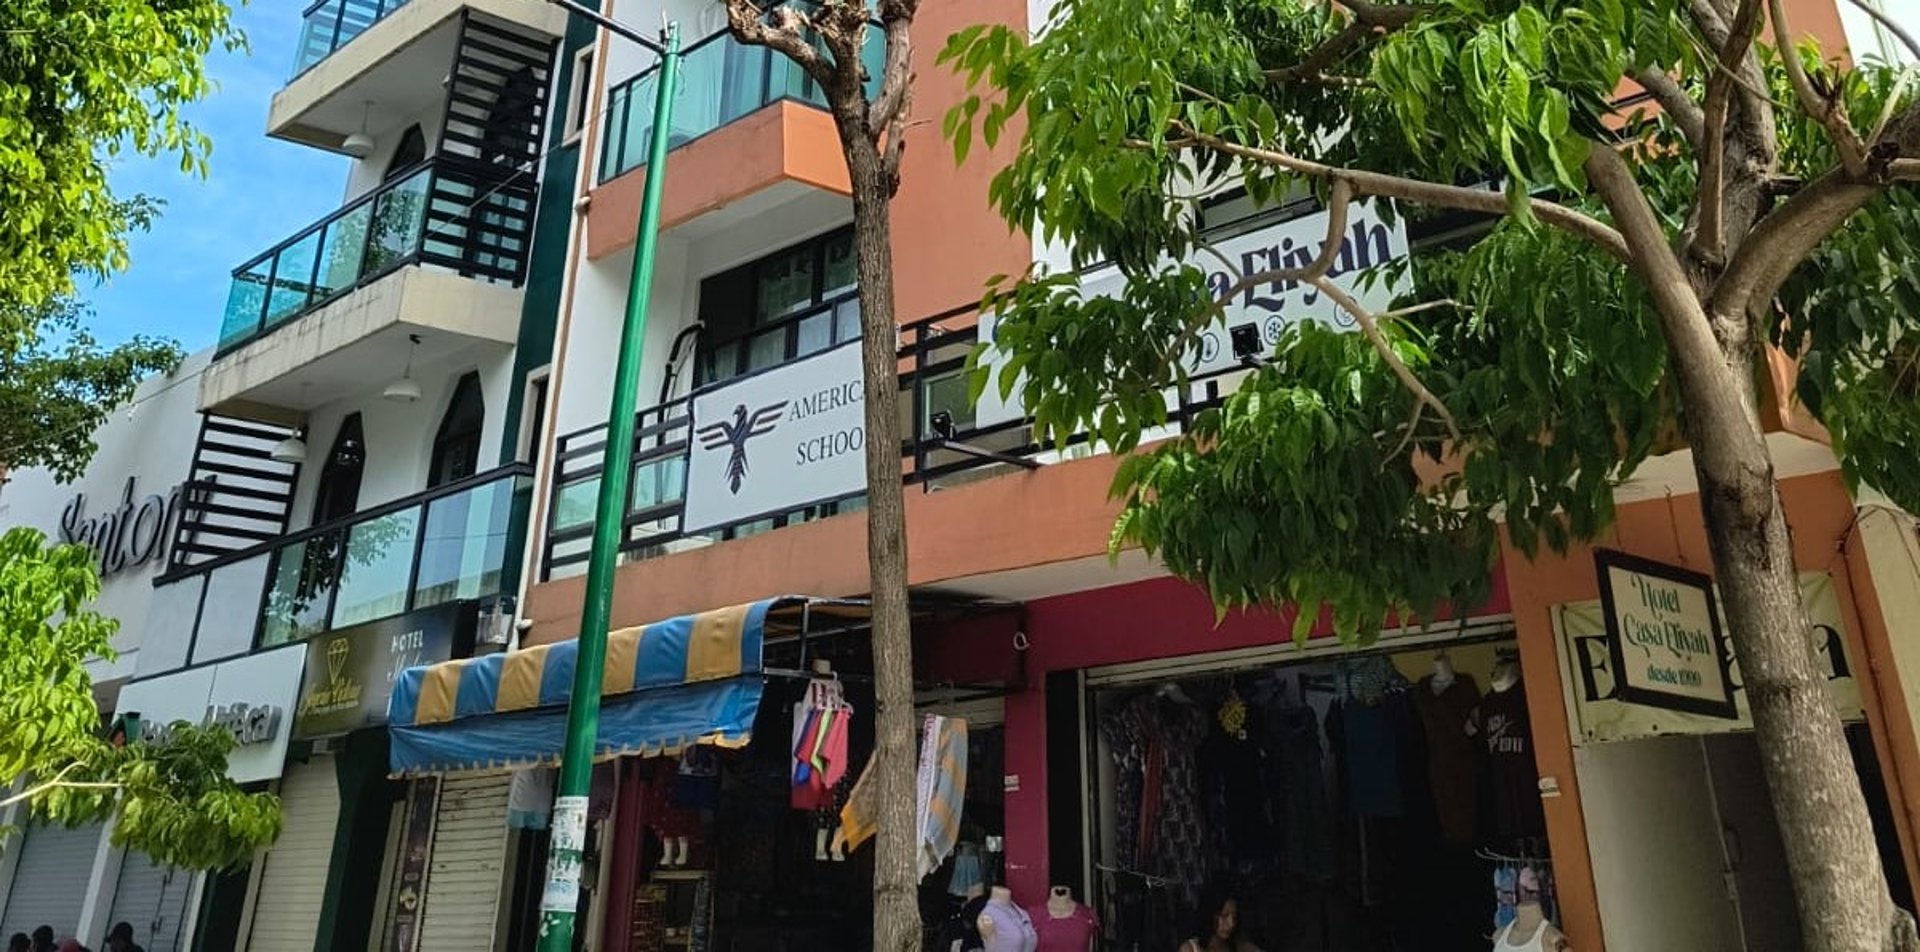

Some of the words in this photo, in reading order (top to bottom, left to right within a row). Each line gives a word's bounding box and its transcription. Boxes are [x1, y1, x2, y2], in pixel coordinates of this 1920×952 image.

[789, 380, 865, 421] AMERIC
[1630, 574, 1681, 621] Hotel
[391, 629, 424, 654] HOTEL
[1624, 612, 1663, 658] Casa
[1664, 621, 1710, 661] Eliyah
[1647, 663, 1677, 684] desde
